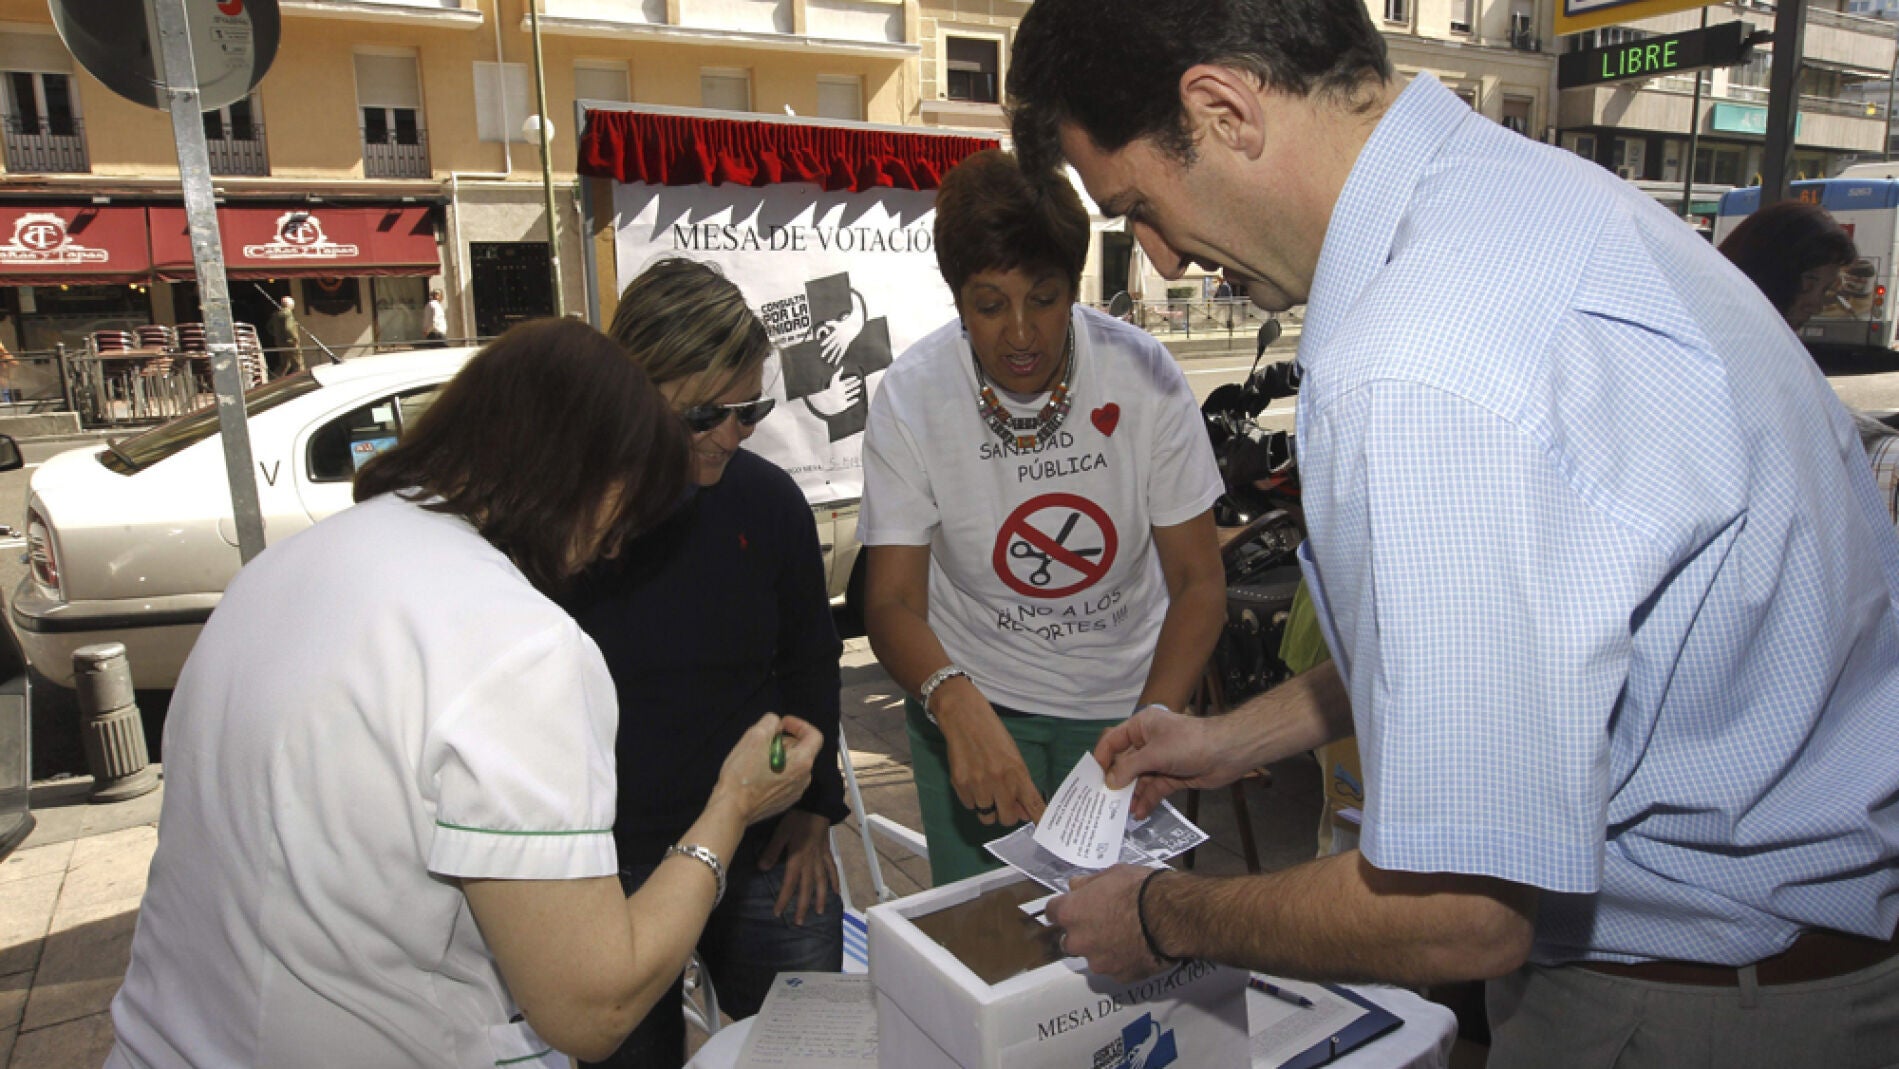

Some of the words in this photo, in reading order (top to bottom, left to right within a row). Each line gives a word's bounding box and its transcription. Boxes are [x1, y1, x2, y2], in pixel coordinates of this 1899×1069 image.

[1602, 40, 1679, 78] LIBRE
[1800, 189, 1817, 204] 61
[673, 223, 761, 251] MESA
[770, 225, 807, 251] DE
[816, 221, 932, 252] VOTACIÓ
[761, 294, 806, 314] CONSULTA
[763, 309, 789, 327] POR
[791, 303, 808, 318] LA
[260, 460, 279, 486] V
[1018, 452, 1108, 482] PÚBLICA
[1062, 605, 1076, 616] A
[1084, 588, 1121, 616] LOS
[998, 613, 1106, 640] REORTES
[1038, 1007, 1094, 1041] MESA
[1098, 993, 1123, 1018] DE
